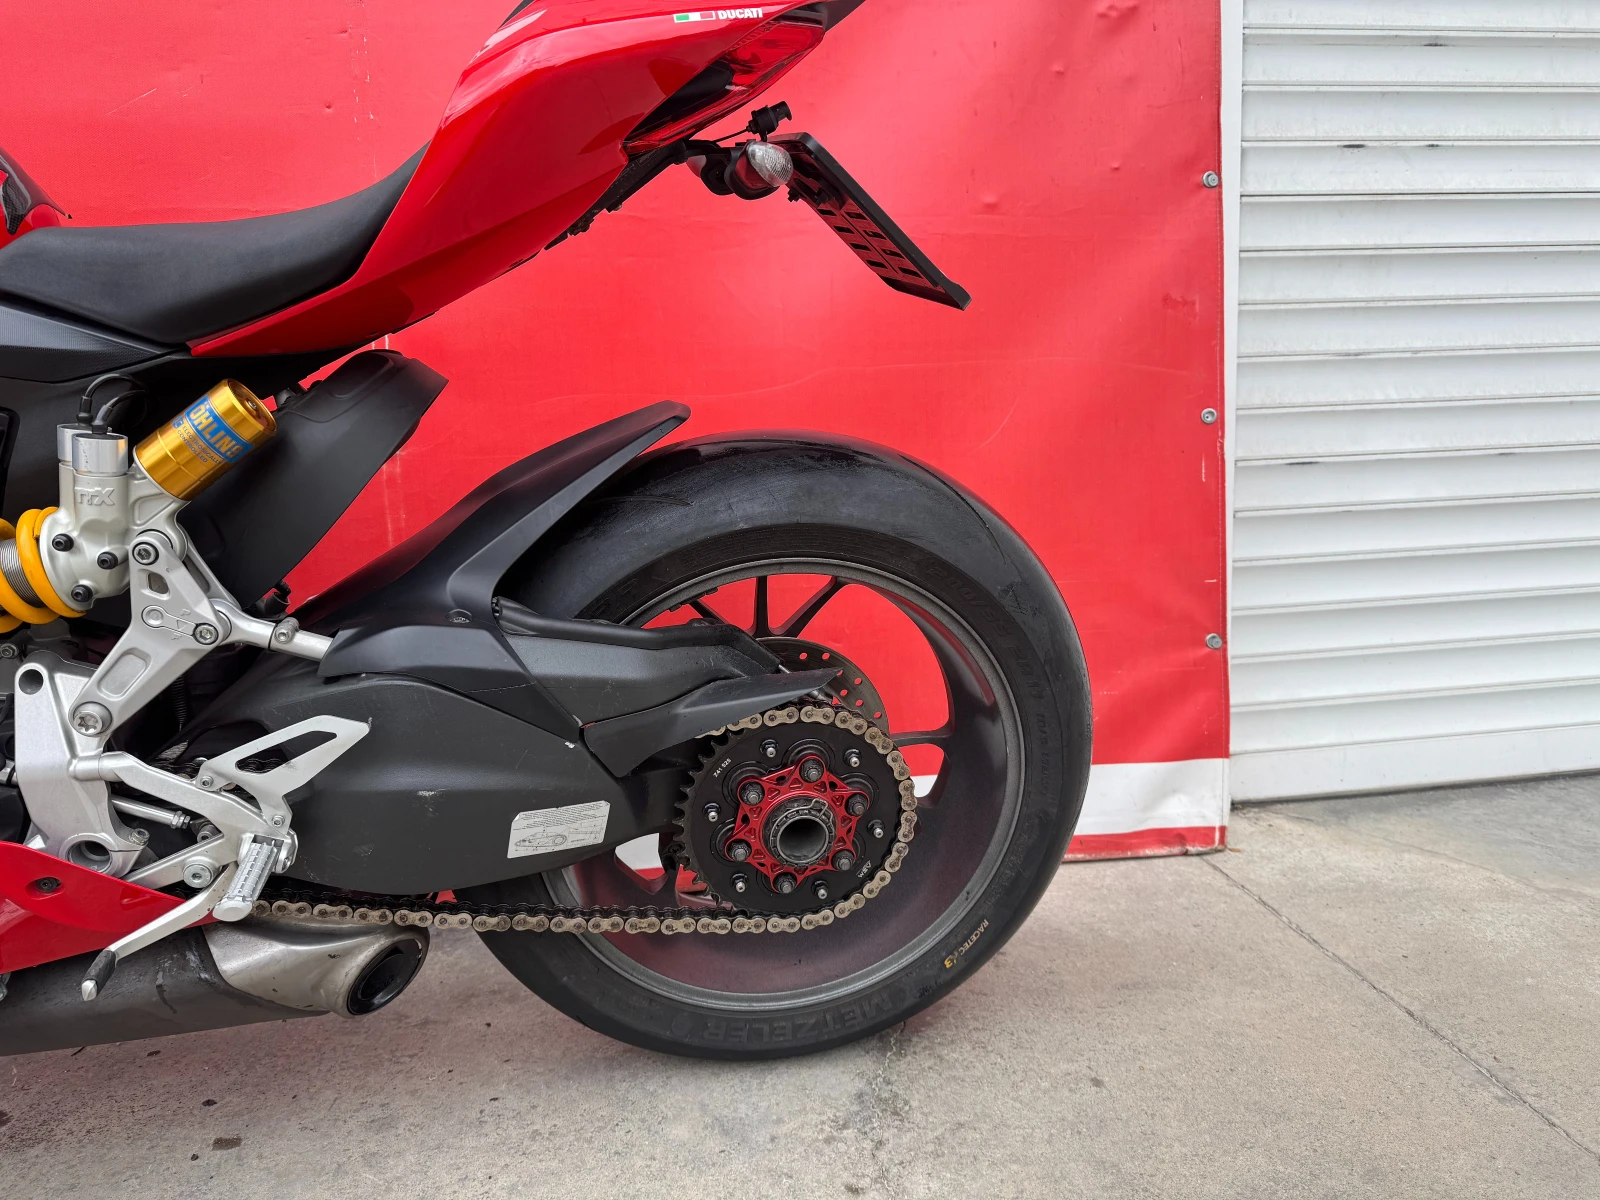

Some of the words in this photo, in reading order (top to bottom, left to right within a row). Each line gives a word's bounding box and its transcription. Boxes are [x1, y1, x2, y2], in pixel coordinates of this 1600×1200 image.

[717, 7, 763, 20] DUCATI
[176, 429, 208, 463] CONTROLLED
[188, 400, 245, 458] ÖHLINS
[958, 918, 990, 956] RACETEC
[703, 991, 894, 1043] METZELER
